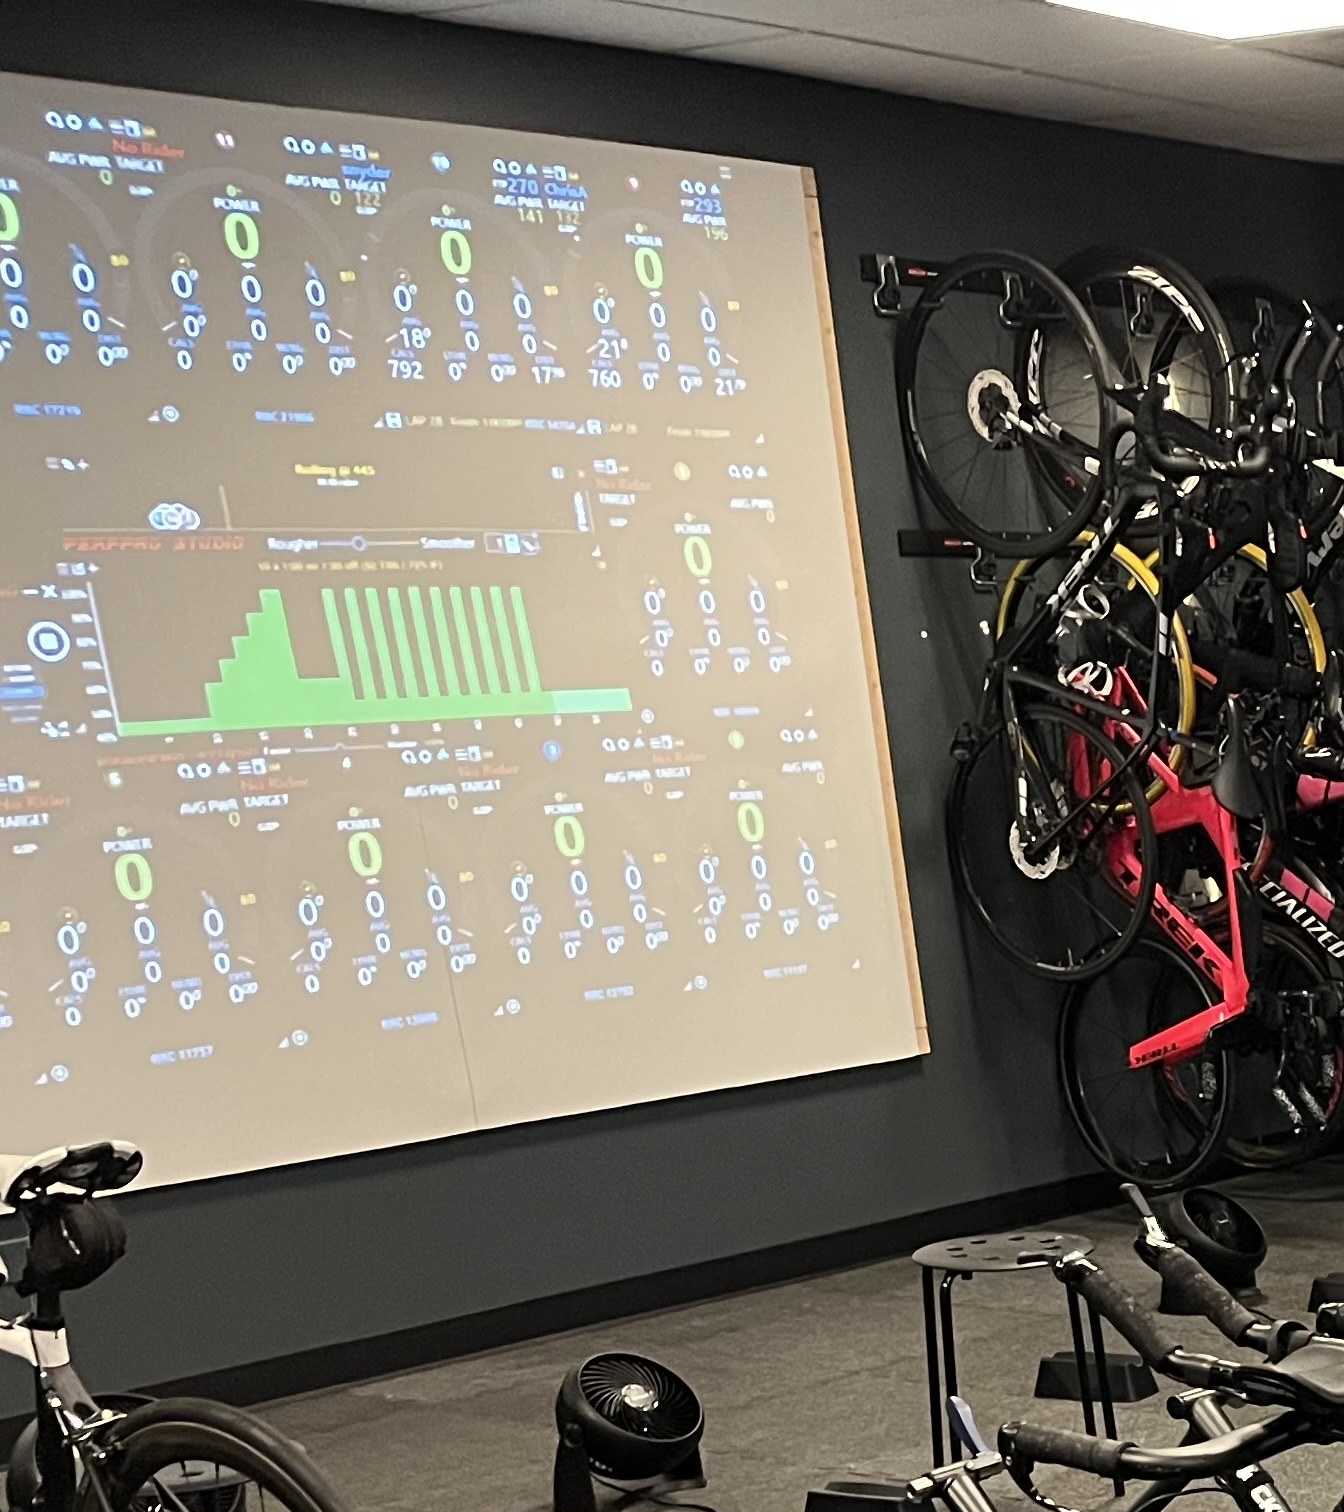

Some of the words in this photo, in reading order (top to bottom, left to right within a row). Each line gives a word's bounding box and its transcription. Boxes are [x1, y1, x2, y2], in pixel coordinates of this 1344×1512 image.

[507, 178, 539, 194] 270
[225, 212, 259, 260] 0
[440, 231, 473, 275] 0
[635, 248, 664, 289] 0
[388, 359, 424, 380] 792
[588, 369, 621, 388] 760
[684, 536, 712, 577] 0
[554, 816, 585, 858] 0
[737, 802, 764, 842] 0
[348, 832, 382, 876] 0
[115, 853, 152, 901] 0
